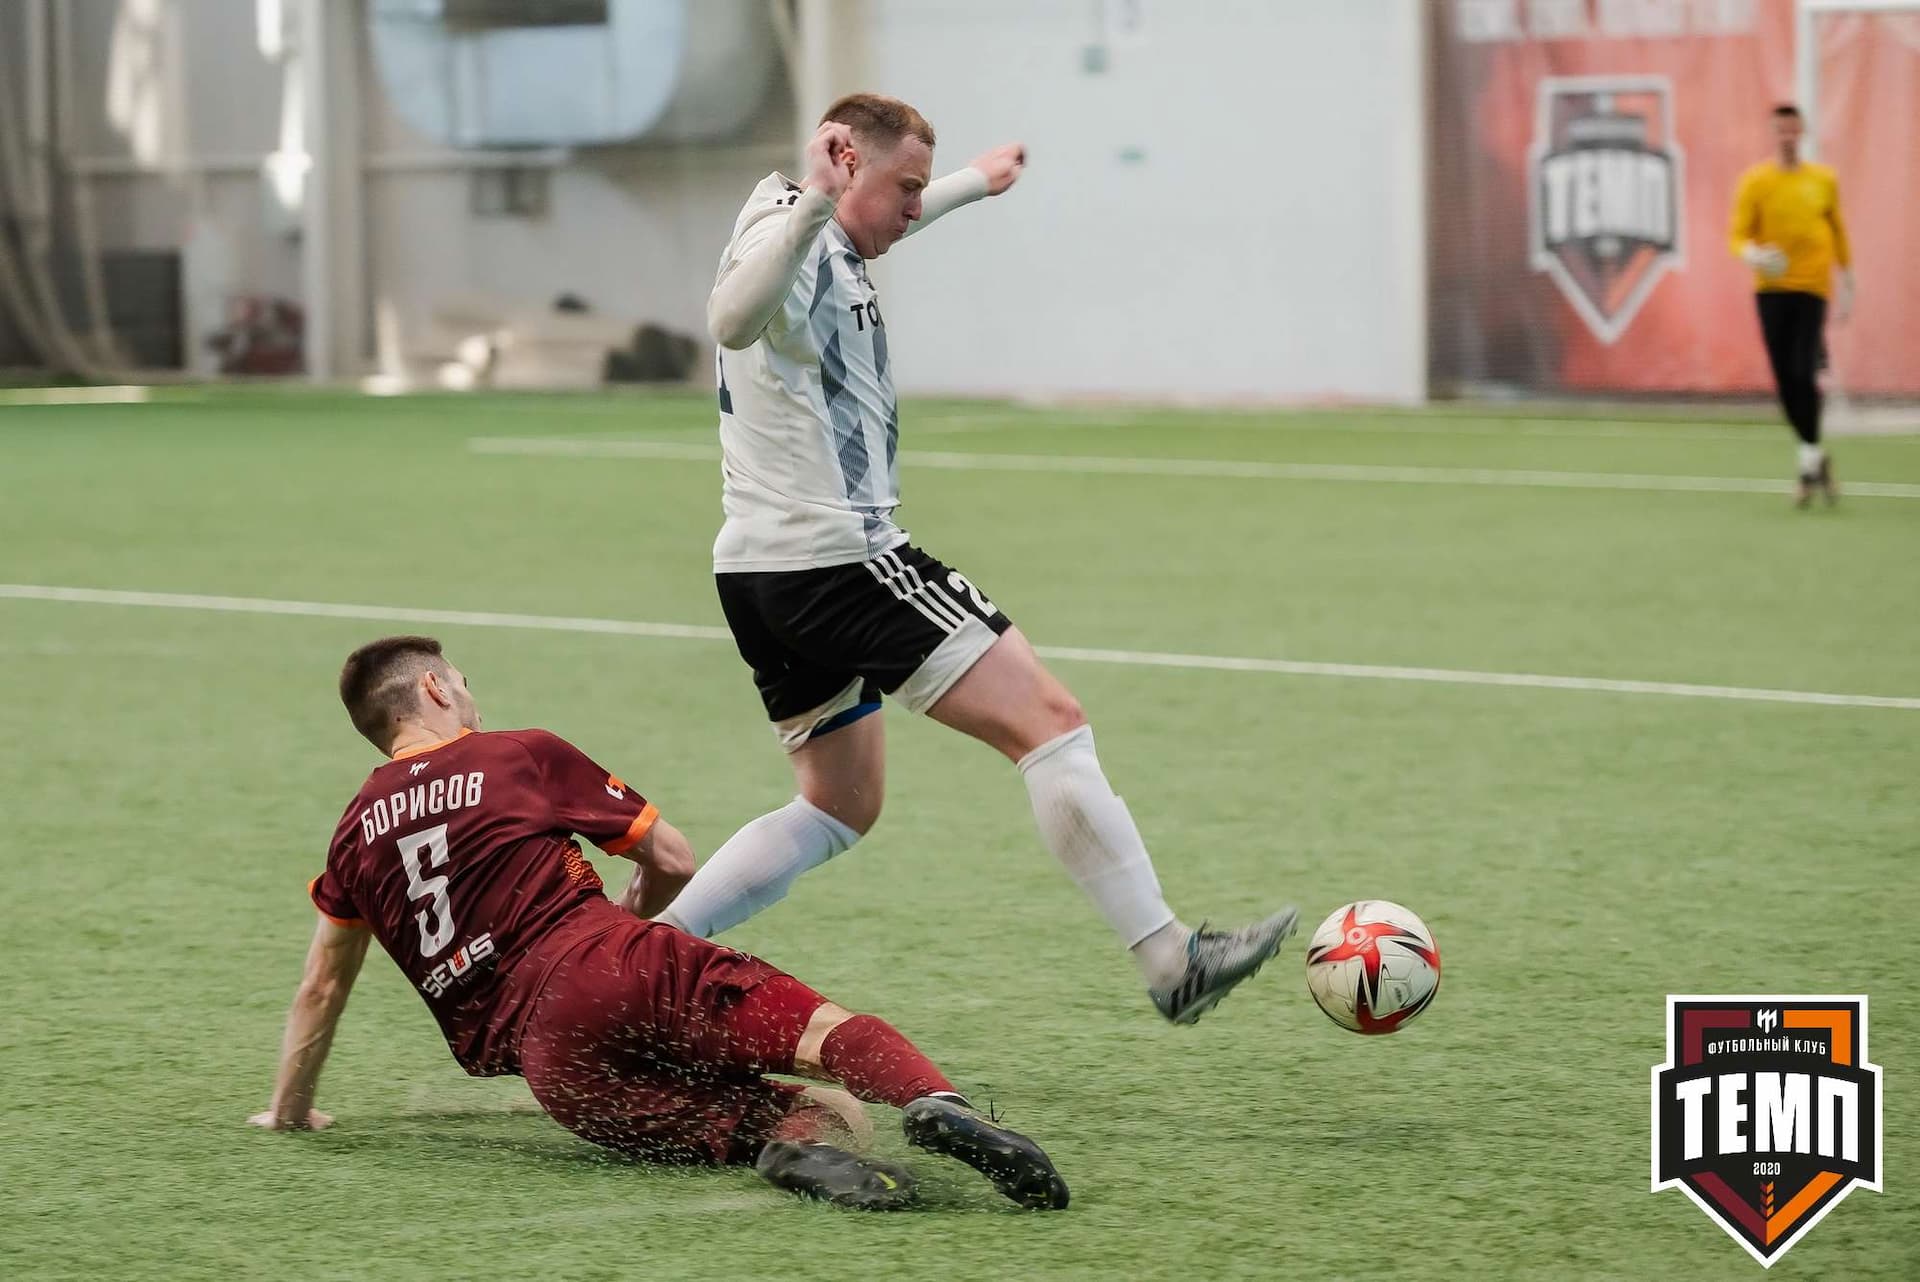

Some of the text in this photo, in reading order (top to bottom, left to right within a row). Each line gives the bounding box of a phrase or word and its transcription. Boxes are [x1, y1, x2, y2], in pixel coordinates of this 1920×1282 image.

[947, 571, 998, 618] 2
[360, 771, 485, 846] БОРИСОВ
[396, 822, 456, 958] 5
[421, 932, 495, 998] SEUS
